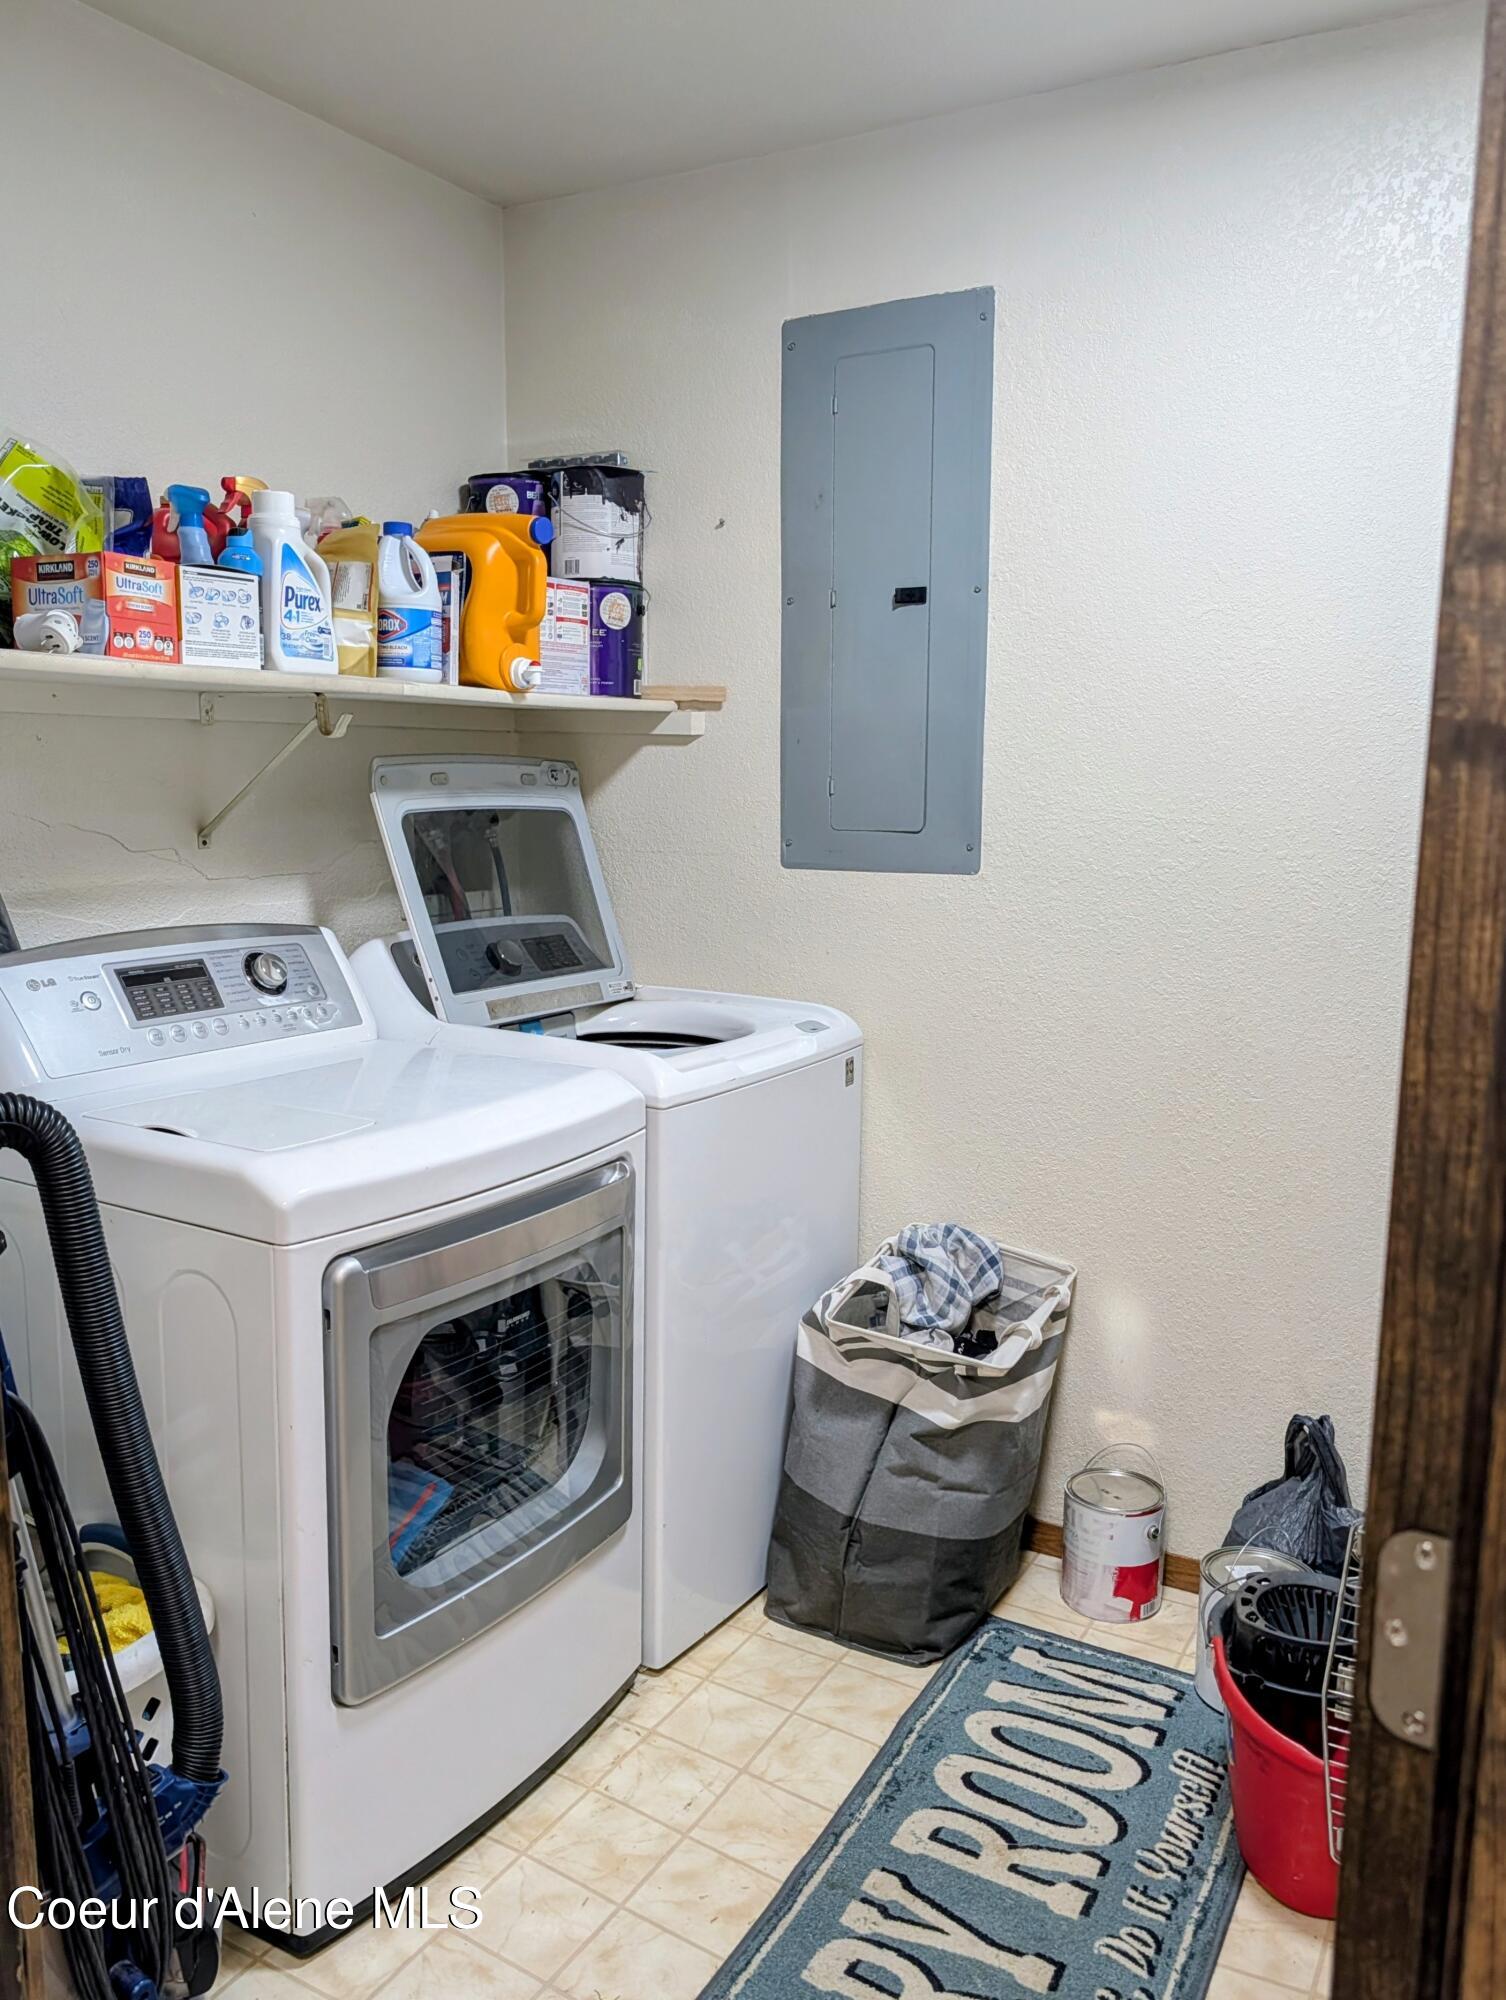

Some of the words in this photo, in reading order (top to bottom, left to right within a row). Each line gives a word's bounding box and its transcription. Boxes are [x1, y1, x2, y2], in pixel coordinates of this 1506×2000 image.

[0, 497, 66, 551] LOWJACKE
[29, 513, 64, 537] TRAP
[38, 562, 73, 574] KIRKLAND
[87, 560, 98, 568] 250
[125, 562, 155, 574] KIRKLAND
[115, 575, 163, 595] UltraSoft
[28, 585, 84, 606] UltraSoft
[284, 585, 321, 613] Purex
[138, 630, 151, 639] 250
[378, 618, 400, 632] OROX
[40, 977, 57, 988] LG
[891, 1645, 1185, 1921] ROOM
[1122, 1884, 1180, 1922] It
[1093, 1924, 1164, 1981] Do
